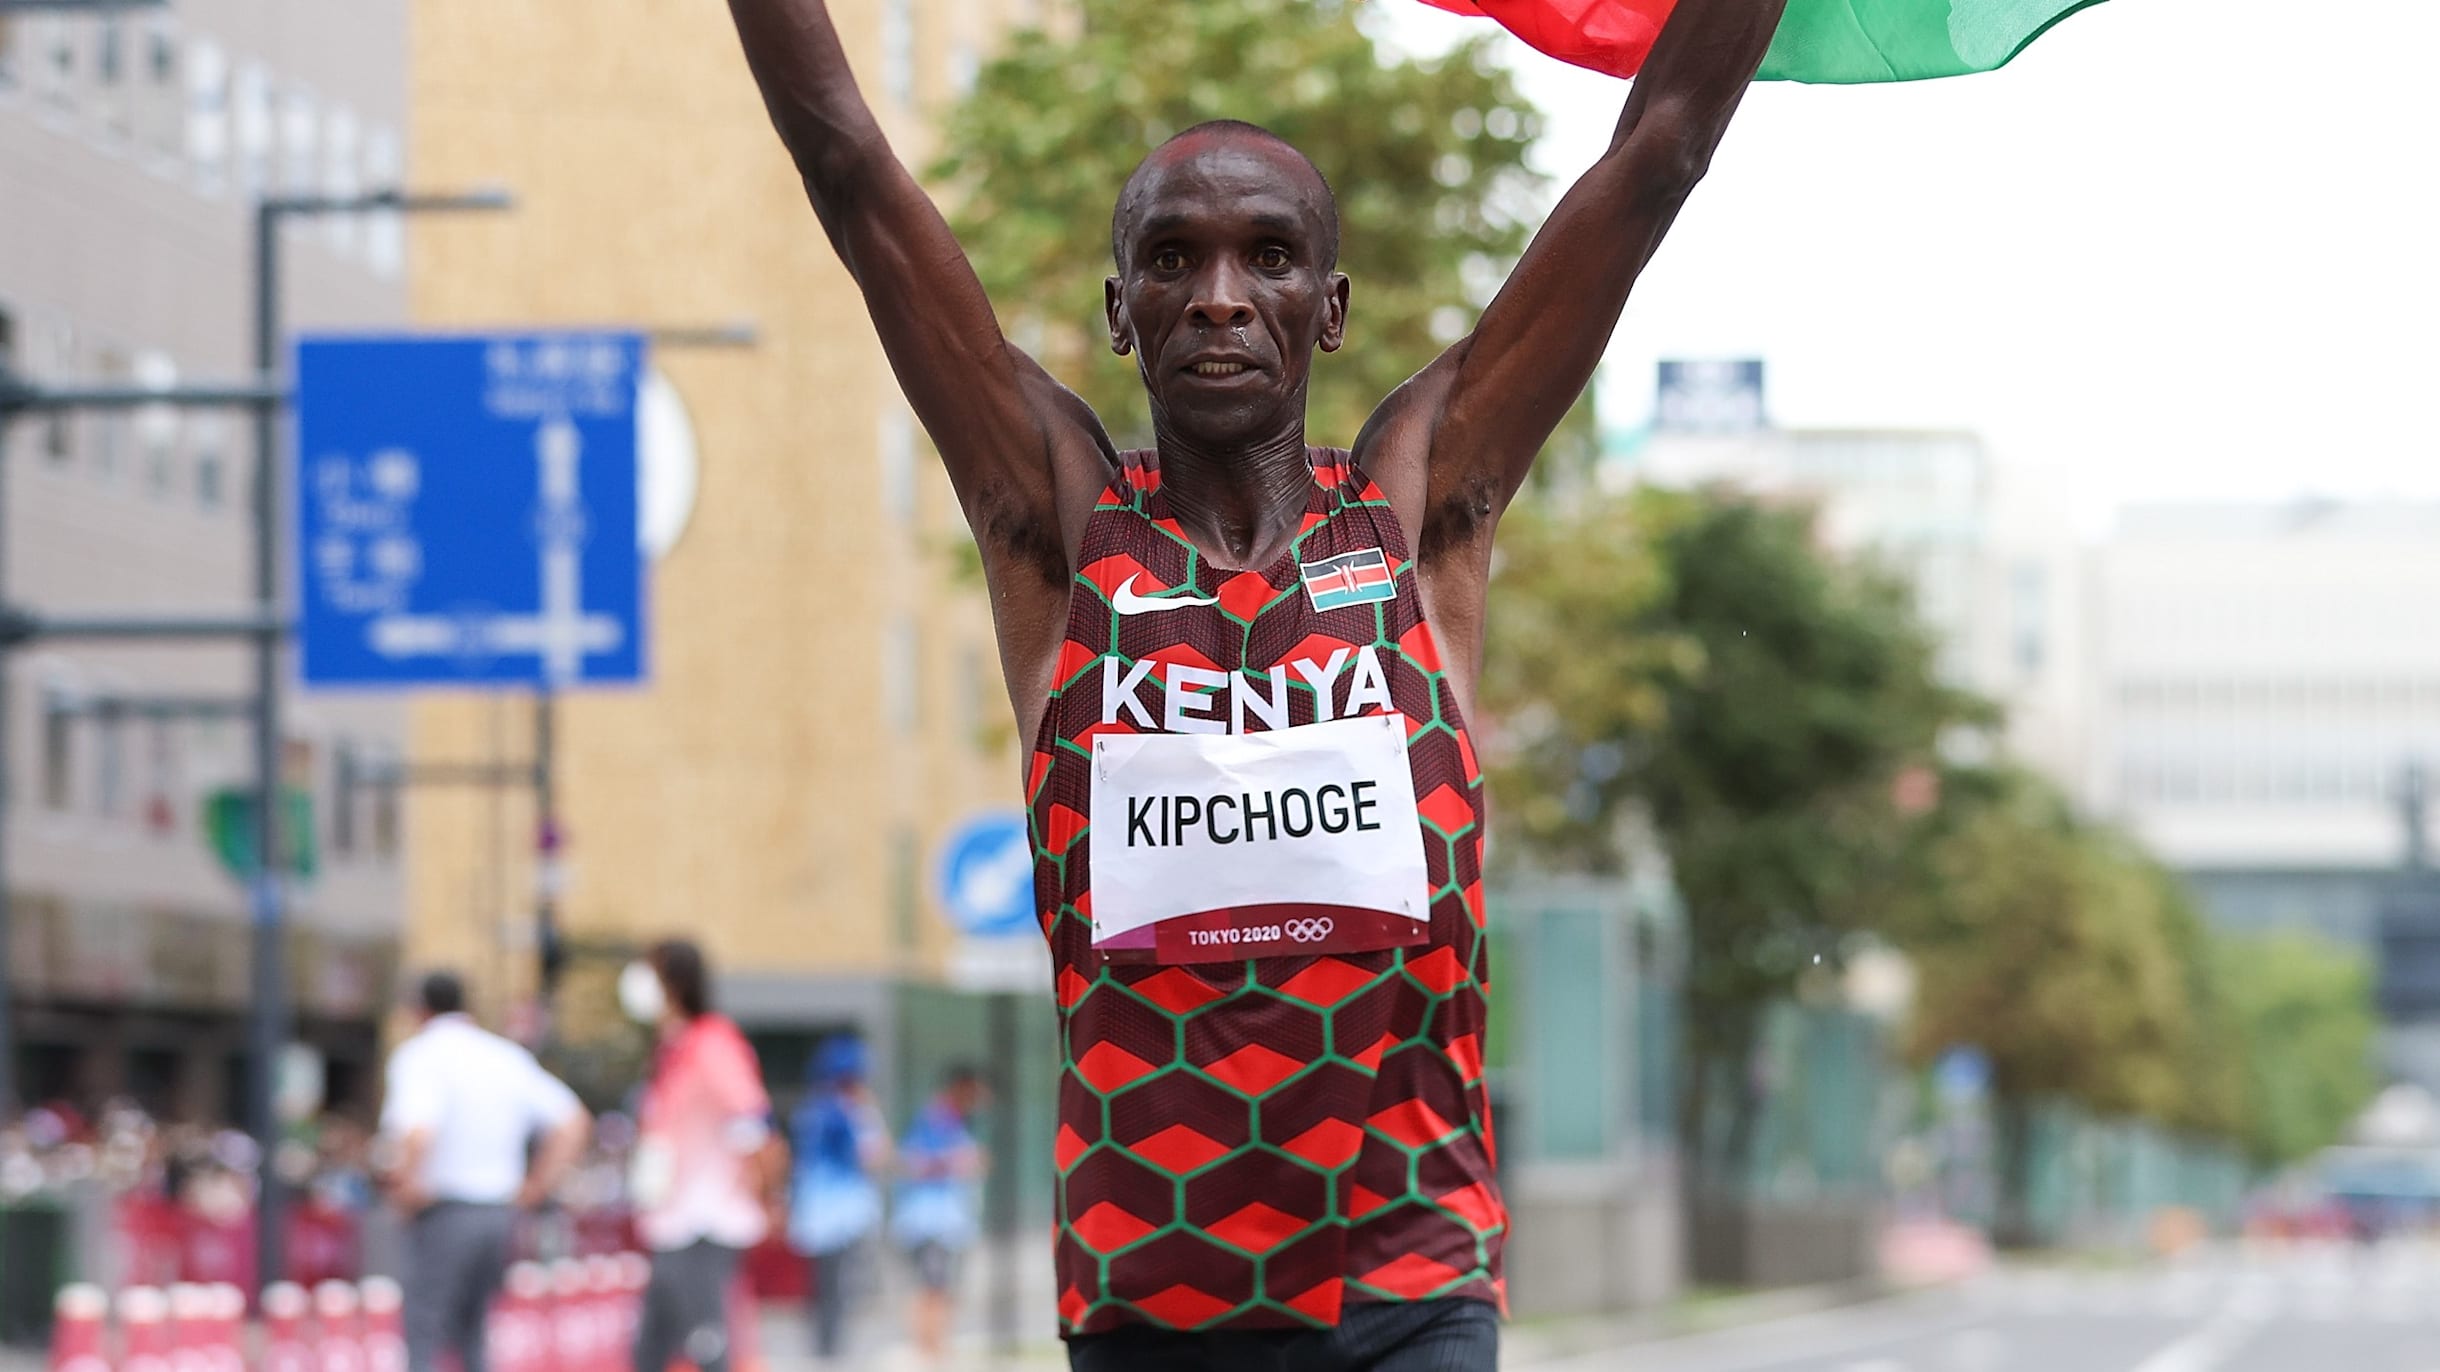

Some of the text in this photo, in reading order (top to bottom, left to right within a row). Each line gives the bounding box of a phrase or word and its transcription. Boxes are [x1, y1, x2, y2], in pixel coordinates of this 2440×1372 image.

[1101, 645, 1394, 735] KENYA
[1127, 780, 1381, 847] KIPCHOGE
[1188, 925, 1281, 946] TOKYO 2020
